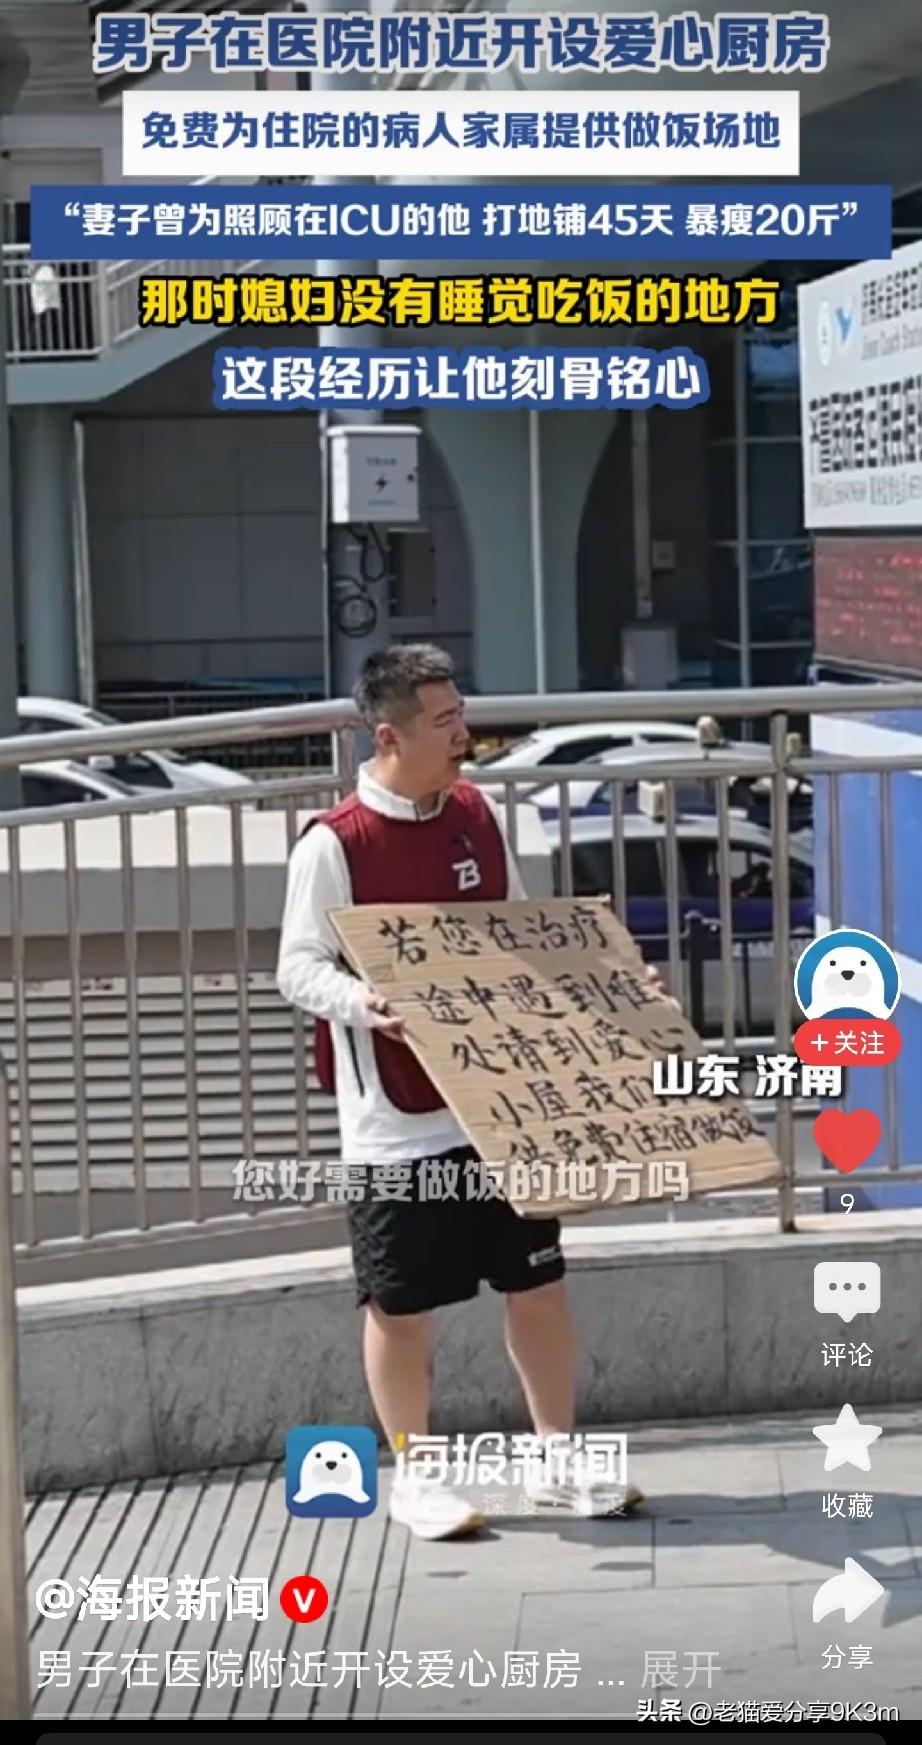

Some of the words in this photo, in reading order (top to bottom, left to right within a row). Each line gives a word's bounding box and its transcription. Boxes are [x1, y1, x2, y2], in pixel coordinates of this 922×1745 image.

[378, 904, 608, 965] 若您在治疗
[452, 1017, 685, 1075] 处请到爱心
[490, 1068, 690, 1129] 小屋我们
